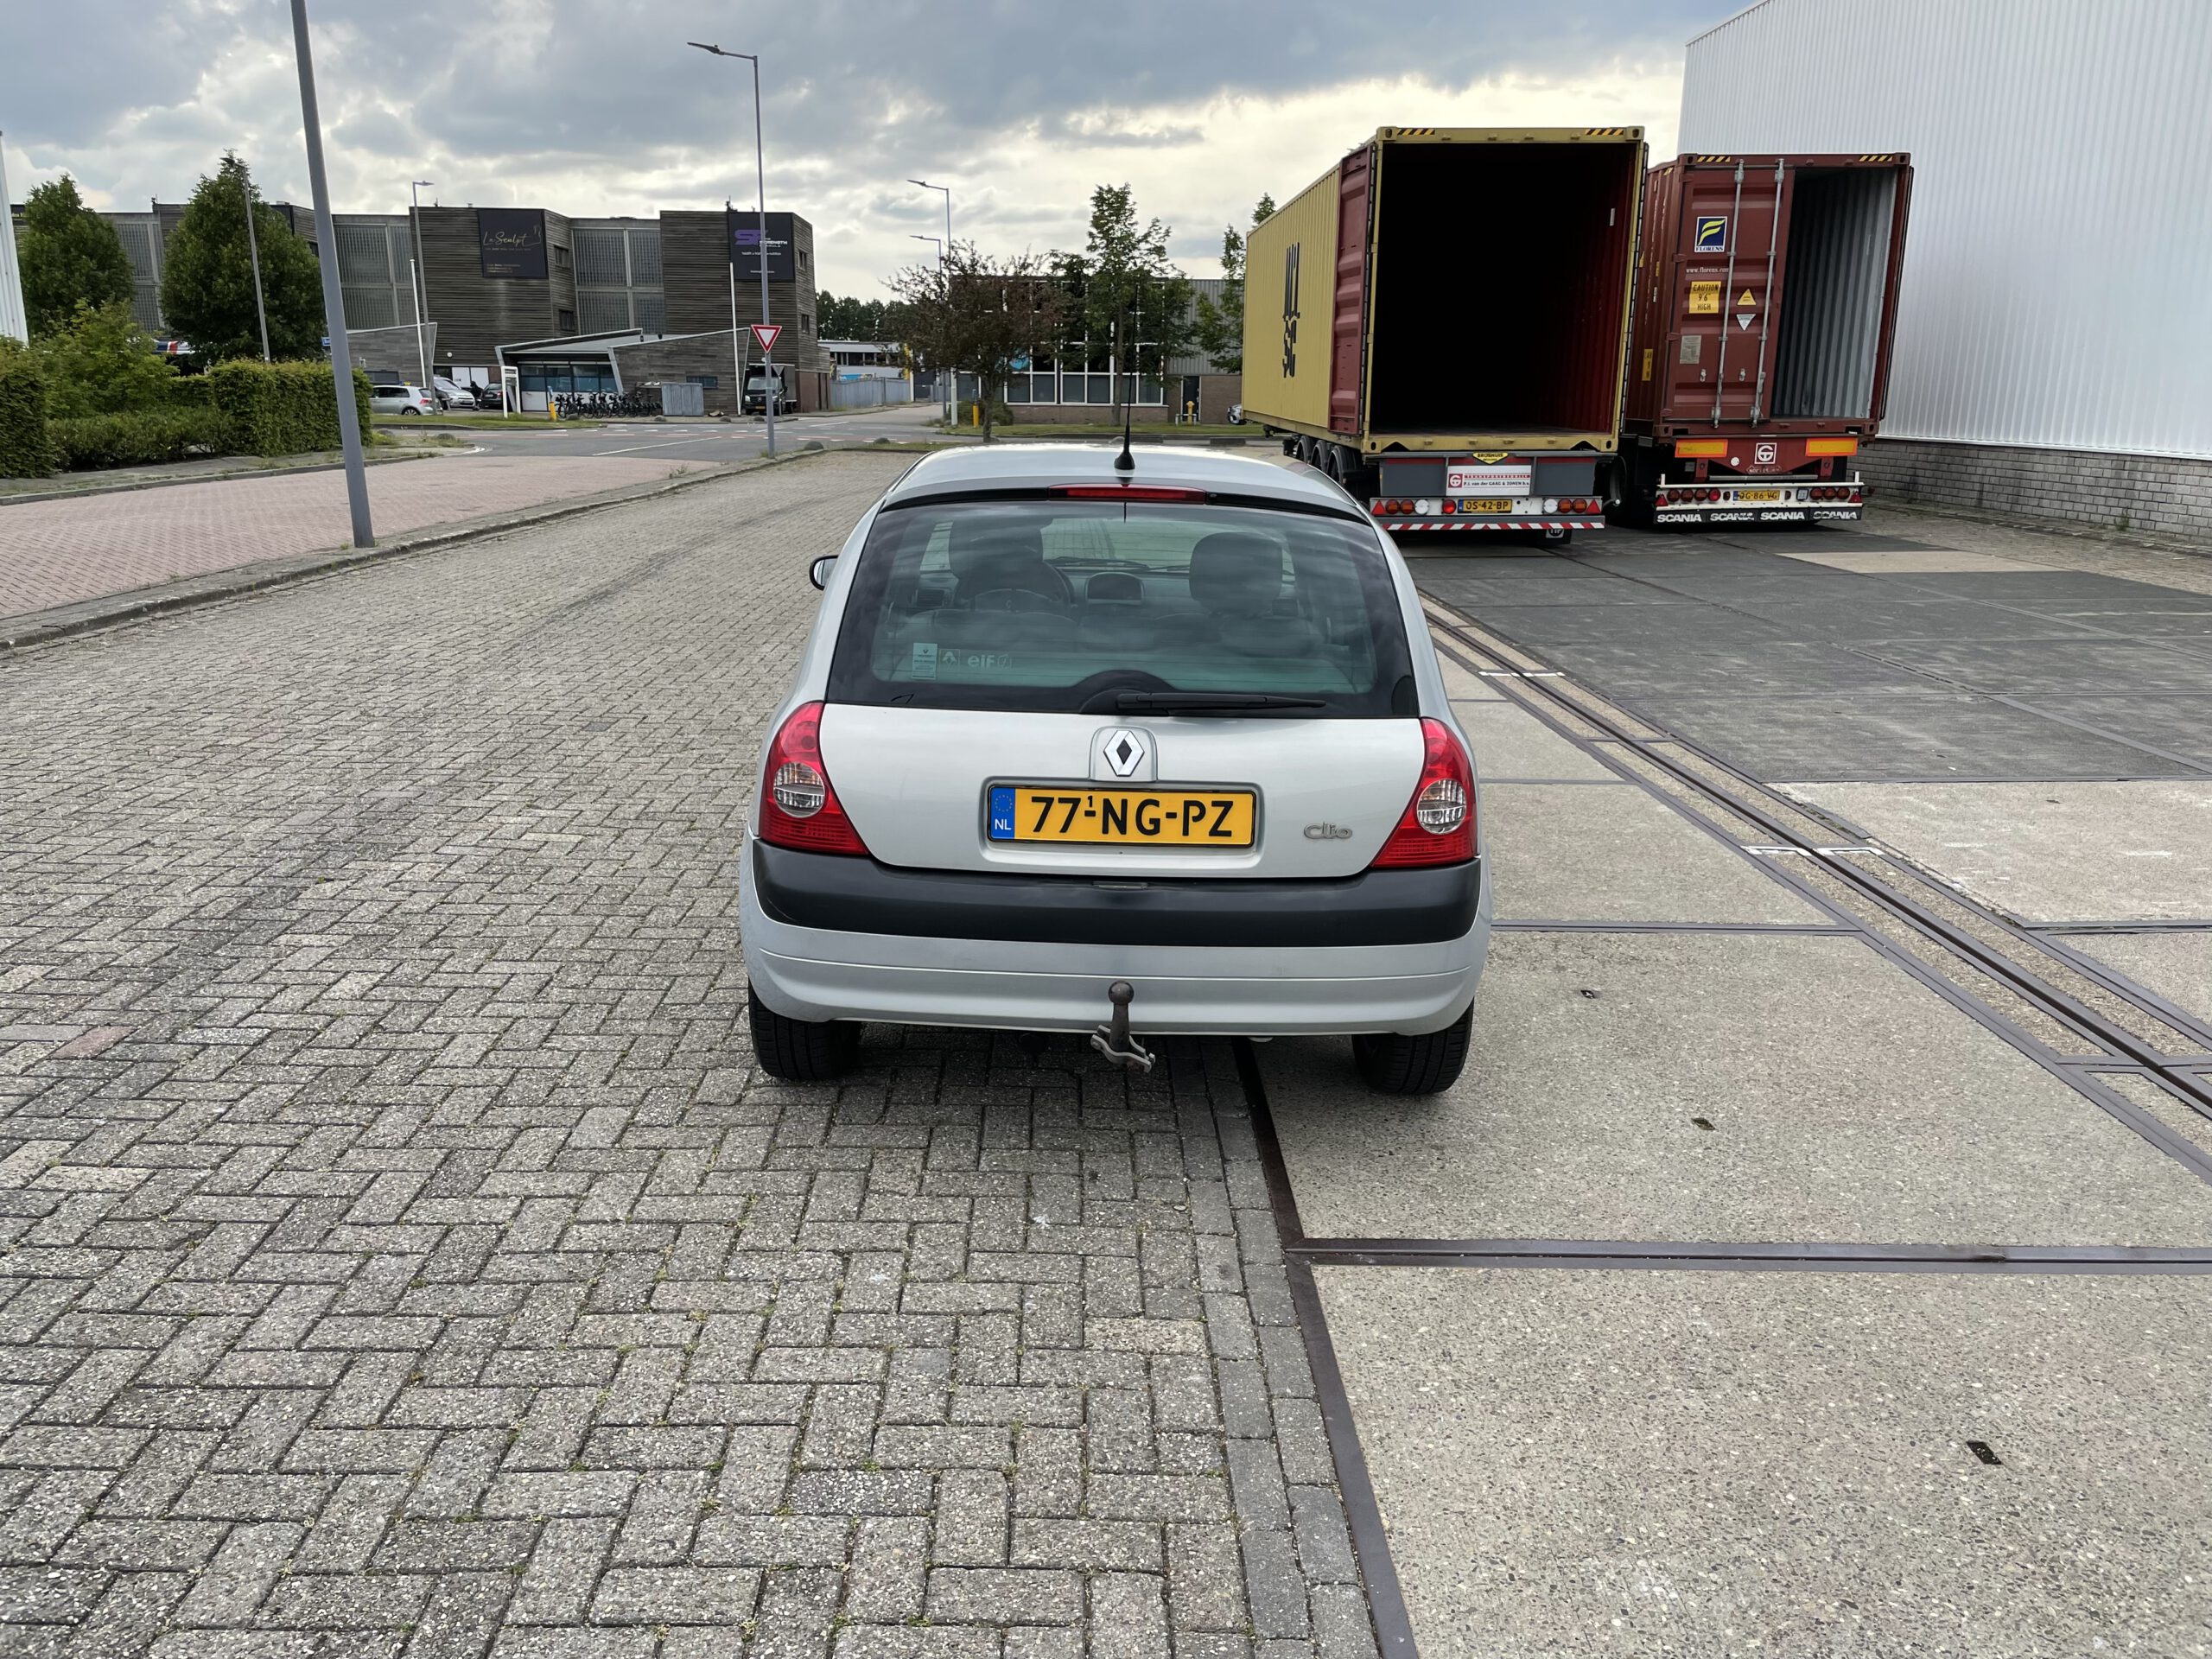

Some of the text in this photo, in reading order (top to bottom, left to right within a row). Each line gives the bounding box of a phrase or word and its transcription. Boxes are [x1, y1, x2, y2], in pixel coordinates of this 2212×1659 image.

[1694, 283, 1719, 292] CAUTION
[1657, 513, 1702, 523] SCANIA
[1760, 512, 1805, 520] SCANIA
[995, 818, 1012, 830] NL
[1303, 821, 1353, 839] Clio
